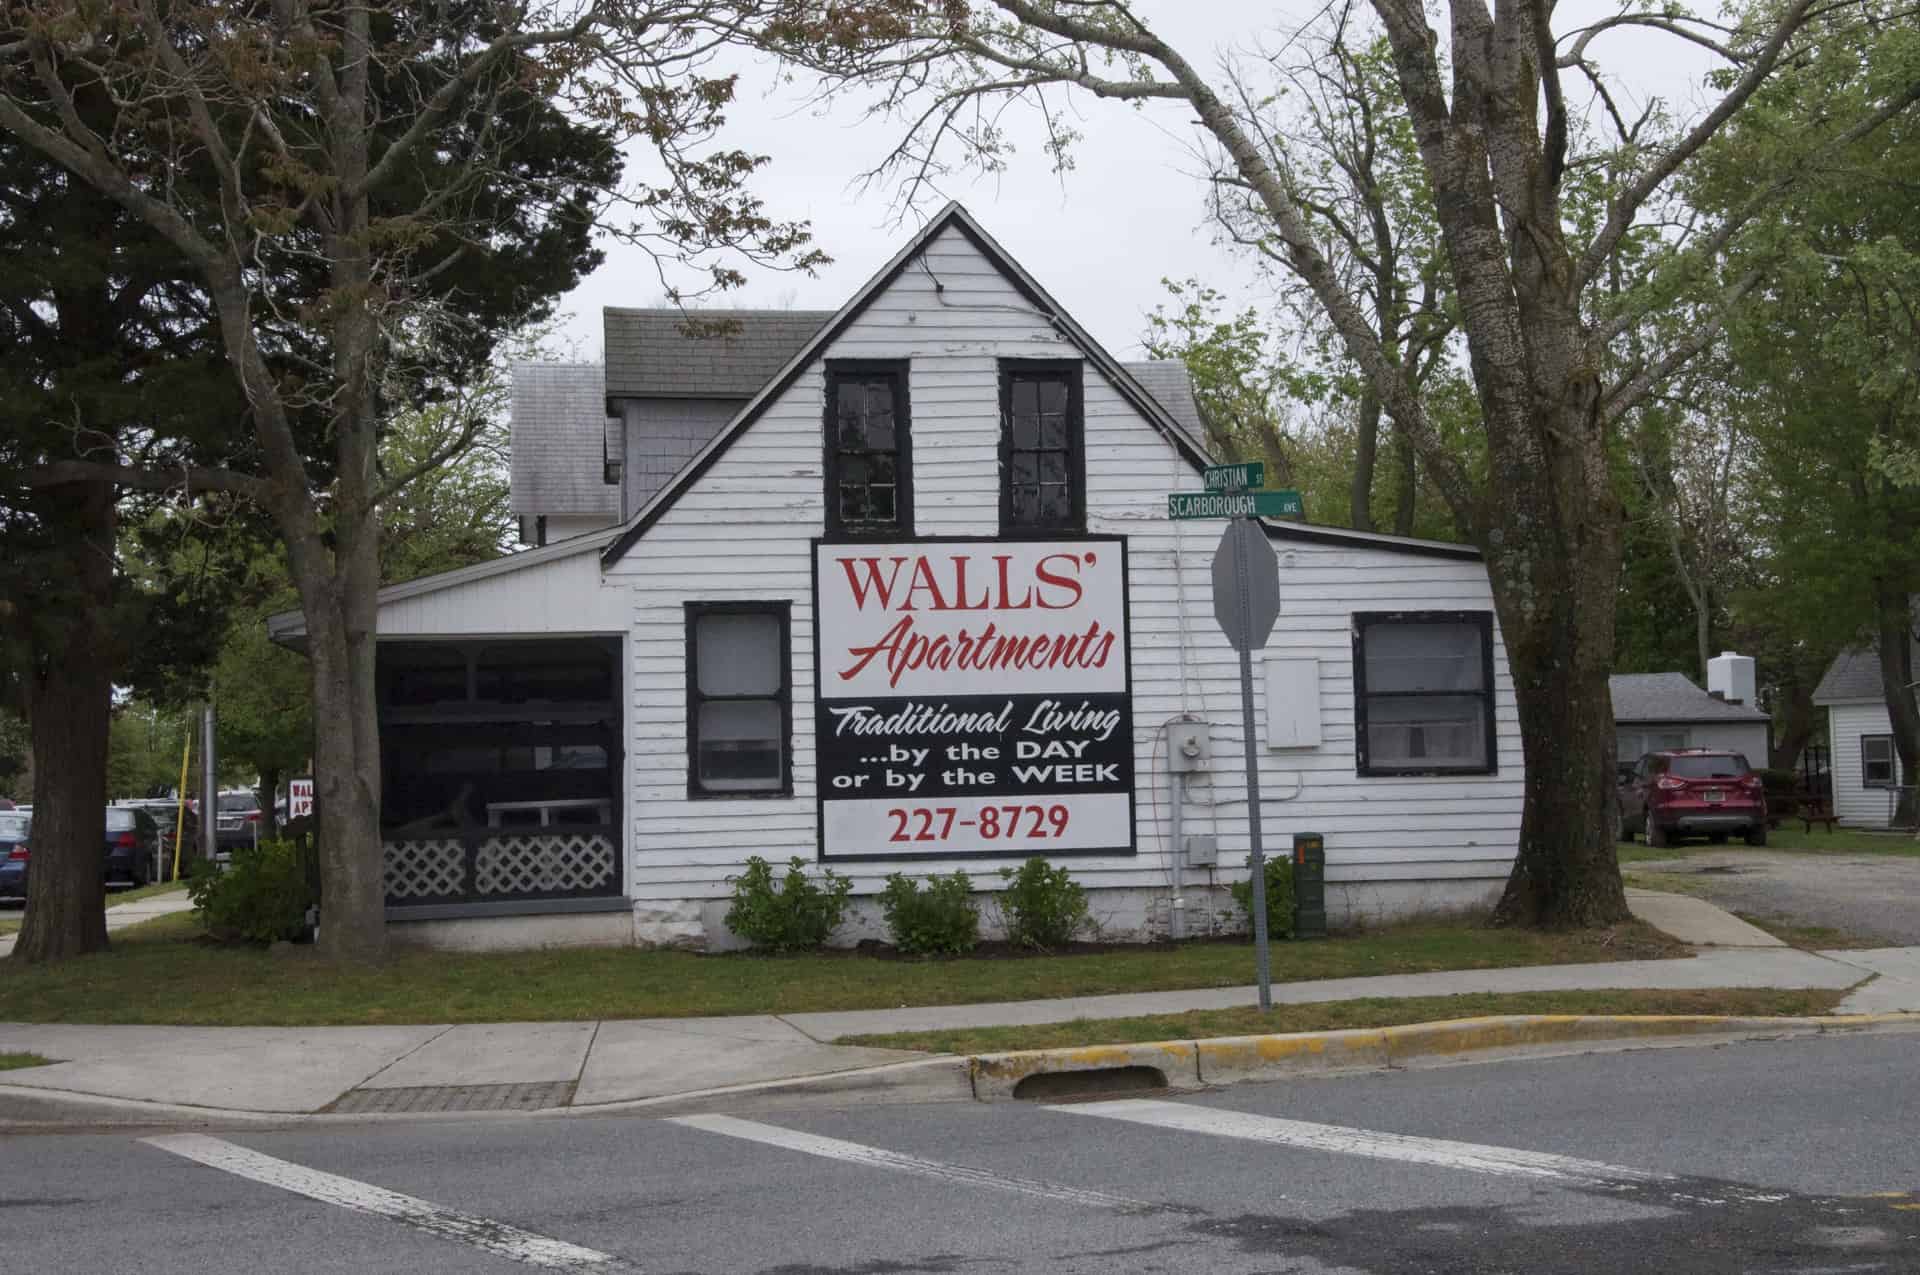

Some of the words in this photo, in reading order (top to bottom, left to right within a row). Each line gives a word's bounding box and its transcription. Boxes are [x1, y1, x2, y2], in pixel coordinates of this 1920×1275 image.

[1204, 467, 1248, 488] CHRISTIAN
[1169, 496, 1256, 516] SCARBOROUGH
[1283, 502, 1297, 513] AVE
[834, 552, 1097, 611] WALLS'
[837, 614, 1115, 688] Apartments
[829, 701, 1014, 736] Traditional
[1022, 700, 1120, 741] Living
[860, 745, 929, 766] ...by
[946, 743, 1001, 761] the
[1016, 740, 1090, 759] DAY
[832, 773, 869, 788] or
[886, 769, 926, 791] by
[942, 768, 996, 786] the
[1011, 763, 1120, 783] WEEK
[888, 805, 1070, 842] 227-8729
